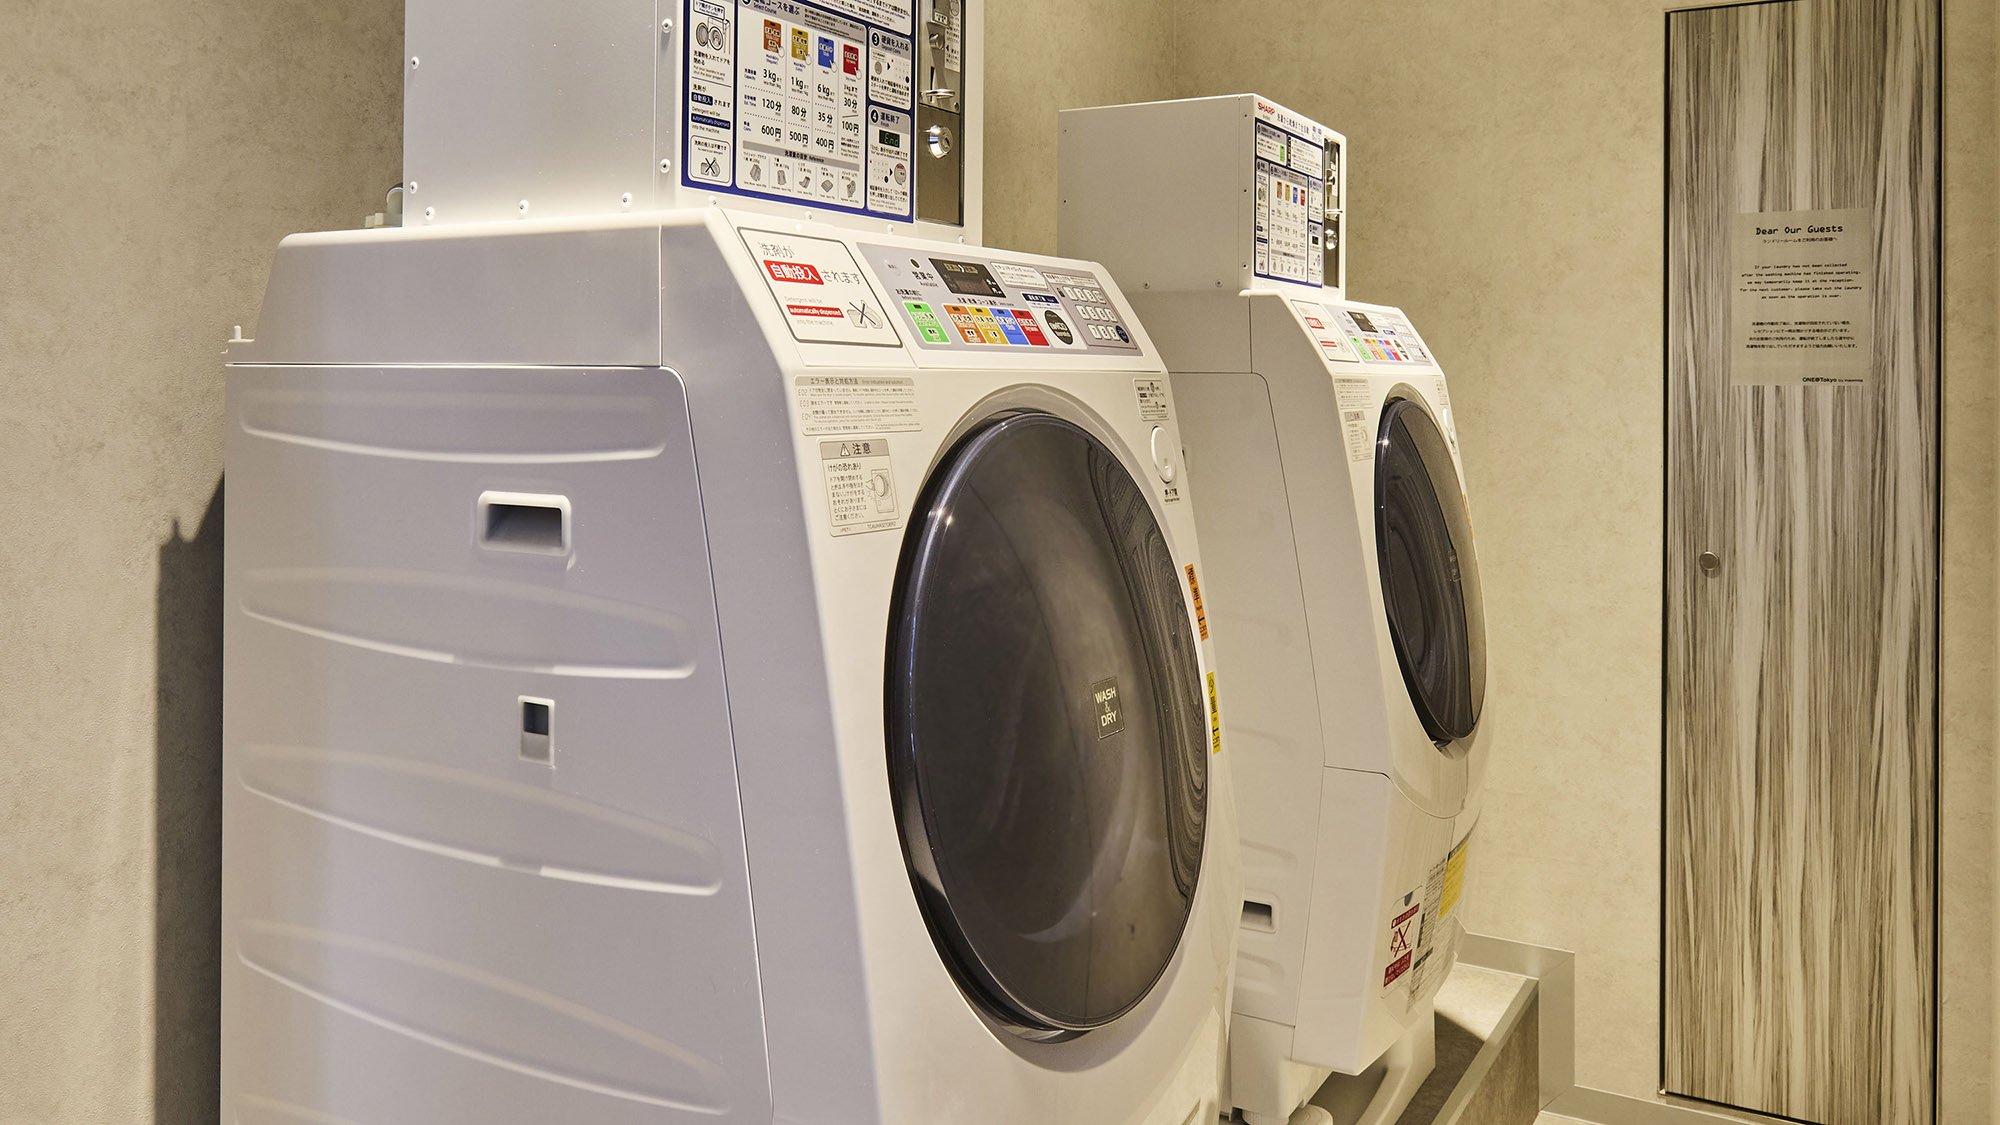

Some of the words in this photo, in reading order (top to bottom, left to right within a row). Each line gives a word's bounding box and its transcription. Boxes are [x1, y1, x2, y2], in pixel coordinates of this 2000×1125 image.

[762, 98, 782, 112] 120分
[843, 97, 858, 110] 30分
[1257, 102, 1275, 115] SHARP
[791, 105, 807, 118] 80分
[818, 111, 833, 125] 35分
[880, 112, 900, 124] 運転終了
[761, 125, 782, 139] 600円
[842, 121, 860, 134] 100円
[789, 131, 809, 145] 500円
[816, 137, 835, 150] 400円
[884, 133, 899, 146] End
[1756, 227, 1778, 236] Dear
[1808, 225, 1843, 233] Guests
[758, 242, 795, 259] 洗剤が
[770, 263, 819, 282] 自動投入
[821, 270, 860, 285] されます
[852, 442, 871, 455] 注意
[1095, 686, 1117, 703] WASH
[1105, 702, 1111, 713] &
[1100, 712, 1117, 727] DRY
